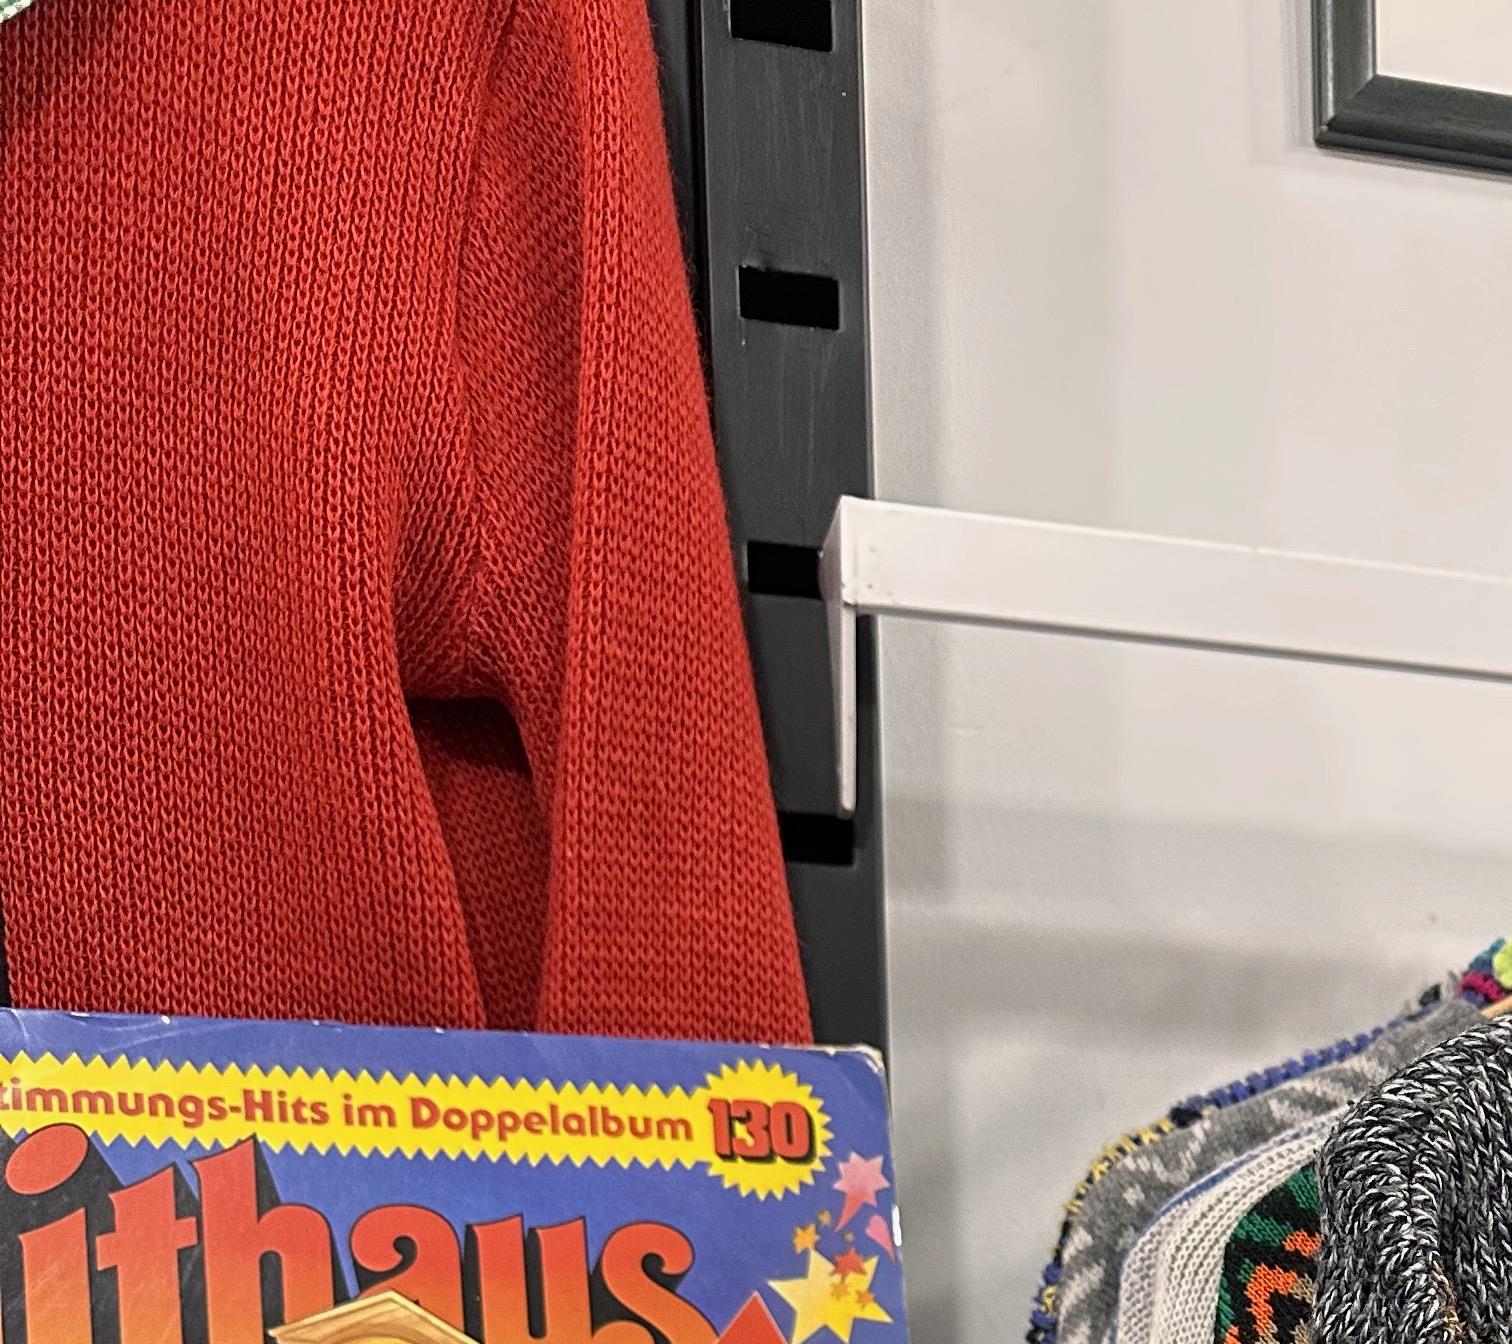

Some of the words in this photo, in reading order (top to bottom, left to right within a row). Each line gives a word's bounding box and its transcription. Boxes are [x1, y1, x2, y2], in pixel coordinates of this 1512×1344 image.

[343, 1094, 397, 1128] im
[410, 1096, 694, 1142] Doppelalbum
[707, 1098, 813, 1162] 130
